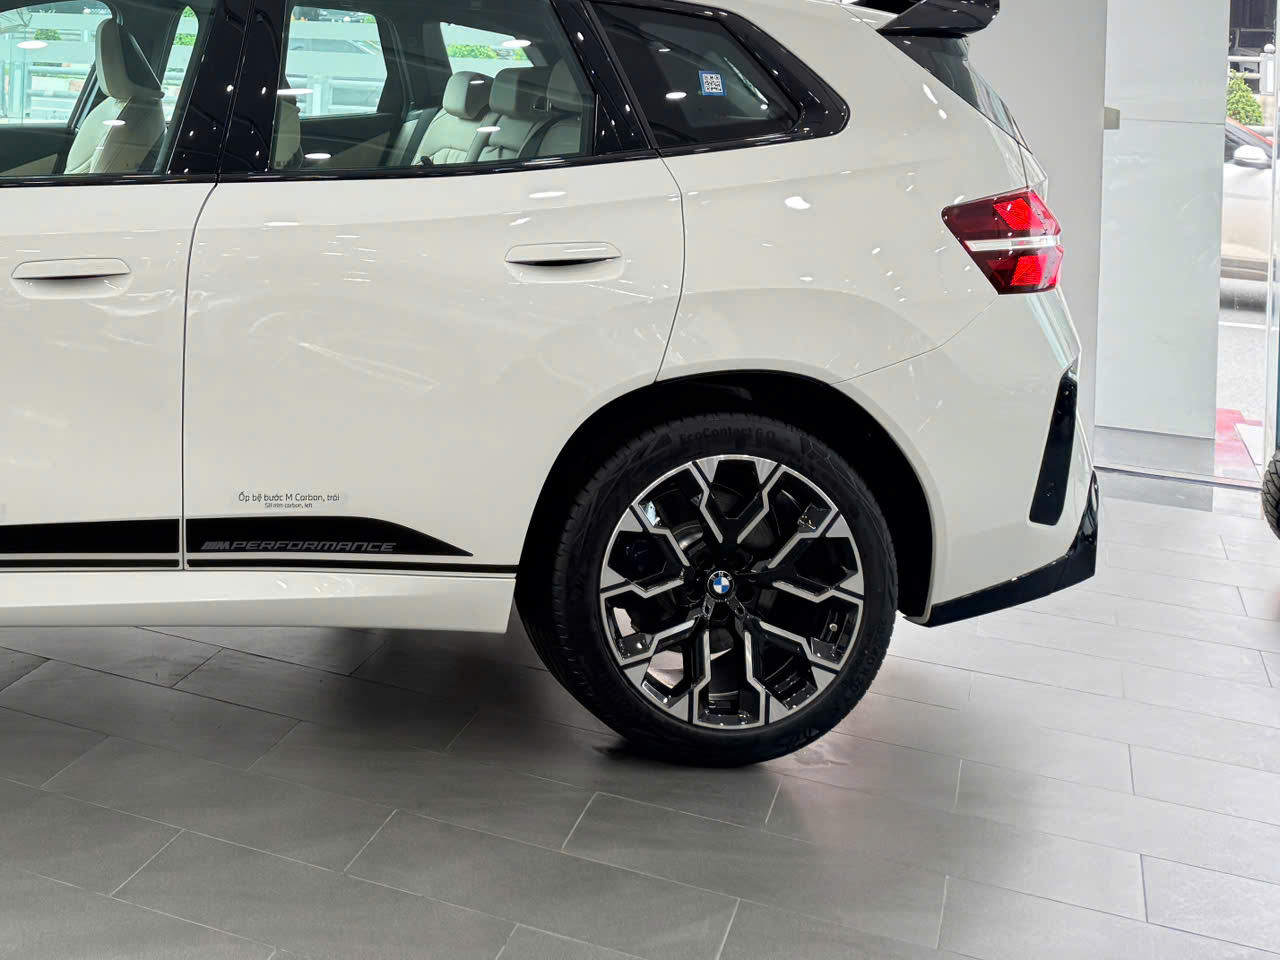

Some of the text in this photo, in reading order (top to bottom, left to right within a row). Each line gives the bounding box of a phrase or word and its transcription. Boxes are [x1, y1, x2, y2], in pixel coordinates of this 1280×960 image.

[238, 490, 250, 502] Ốp
[285, 493, 293, 501] M
[295, 493, 325, 502] Carbon,
[327, 493, 340, 501] trái
[231, 540, 397, 552] PERFORMANCE
